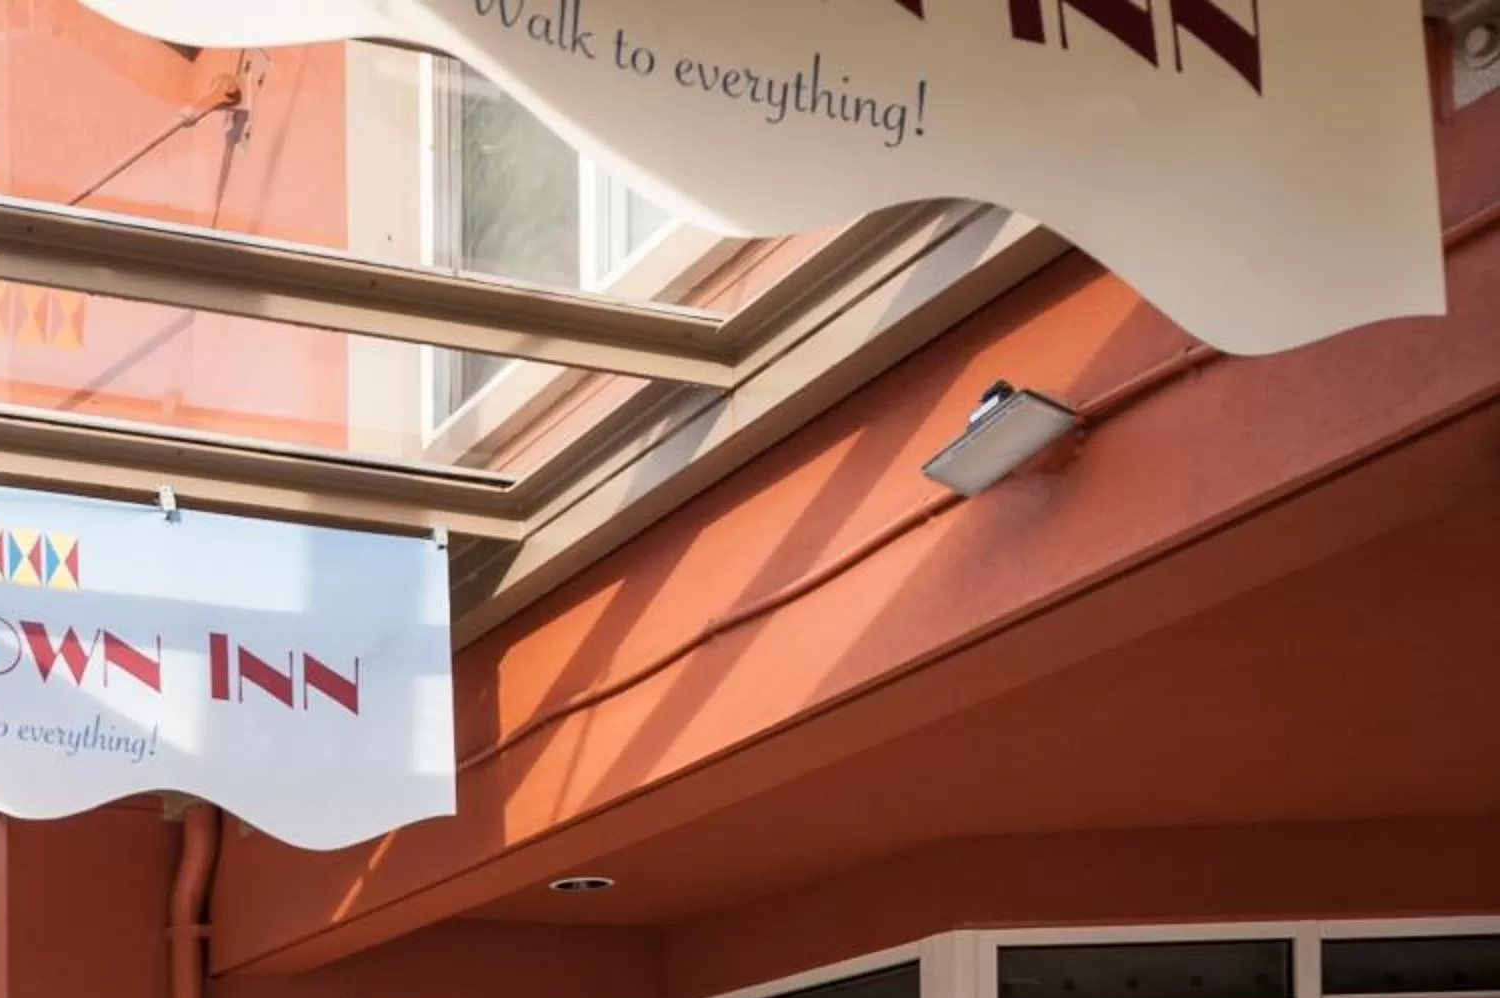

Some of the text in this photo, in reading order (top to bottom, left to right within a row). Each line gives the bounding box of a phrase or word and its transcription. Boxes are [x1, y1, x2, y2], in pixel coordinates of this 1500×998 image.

[613, 29, 655, 76] to
[675, 52, 927, 148] everything!
[208, 632, 359, 716] INN
[17, 712, 159, 764] everything!
